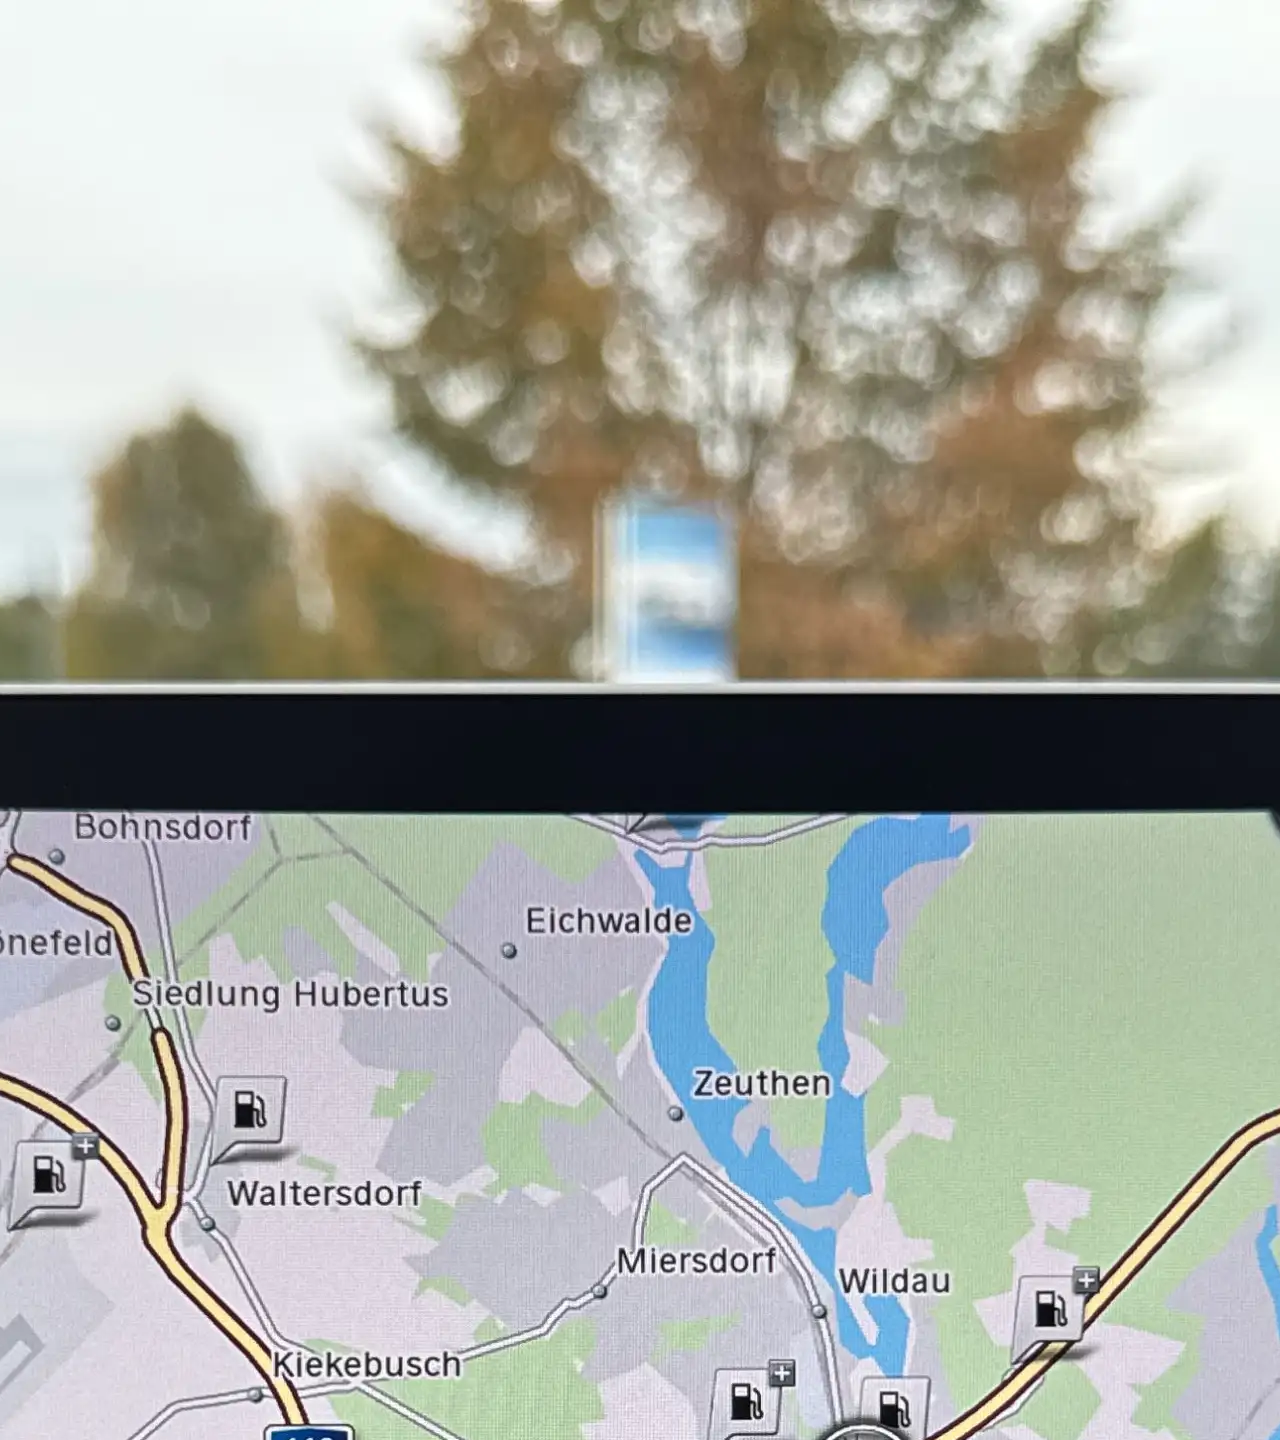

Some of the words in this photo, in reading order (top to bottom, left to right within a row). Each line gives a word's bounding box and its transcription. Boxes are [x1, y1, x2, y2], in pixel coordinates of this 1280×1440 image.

[75, 813, 252, 842] Bohnsdorf
[526, 906, 692, 934] Eichwalde
[133, 980, 280, 1013] Siedlung
[295, 981, 449, 1007] Hubertus
[693, 1068, 832, 1097] Zeuthen
[228, 1180, 423, 1207] Waltersdorf
[617, 1246, 778, 1275] Miersdorf
[839, 1267, 951, 1295] Wildau
[273, 1351, 462, 1378] Kiekebusch
